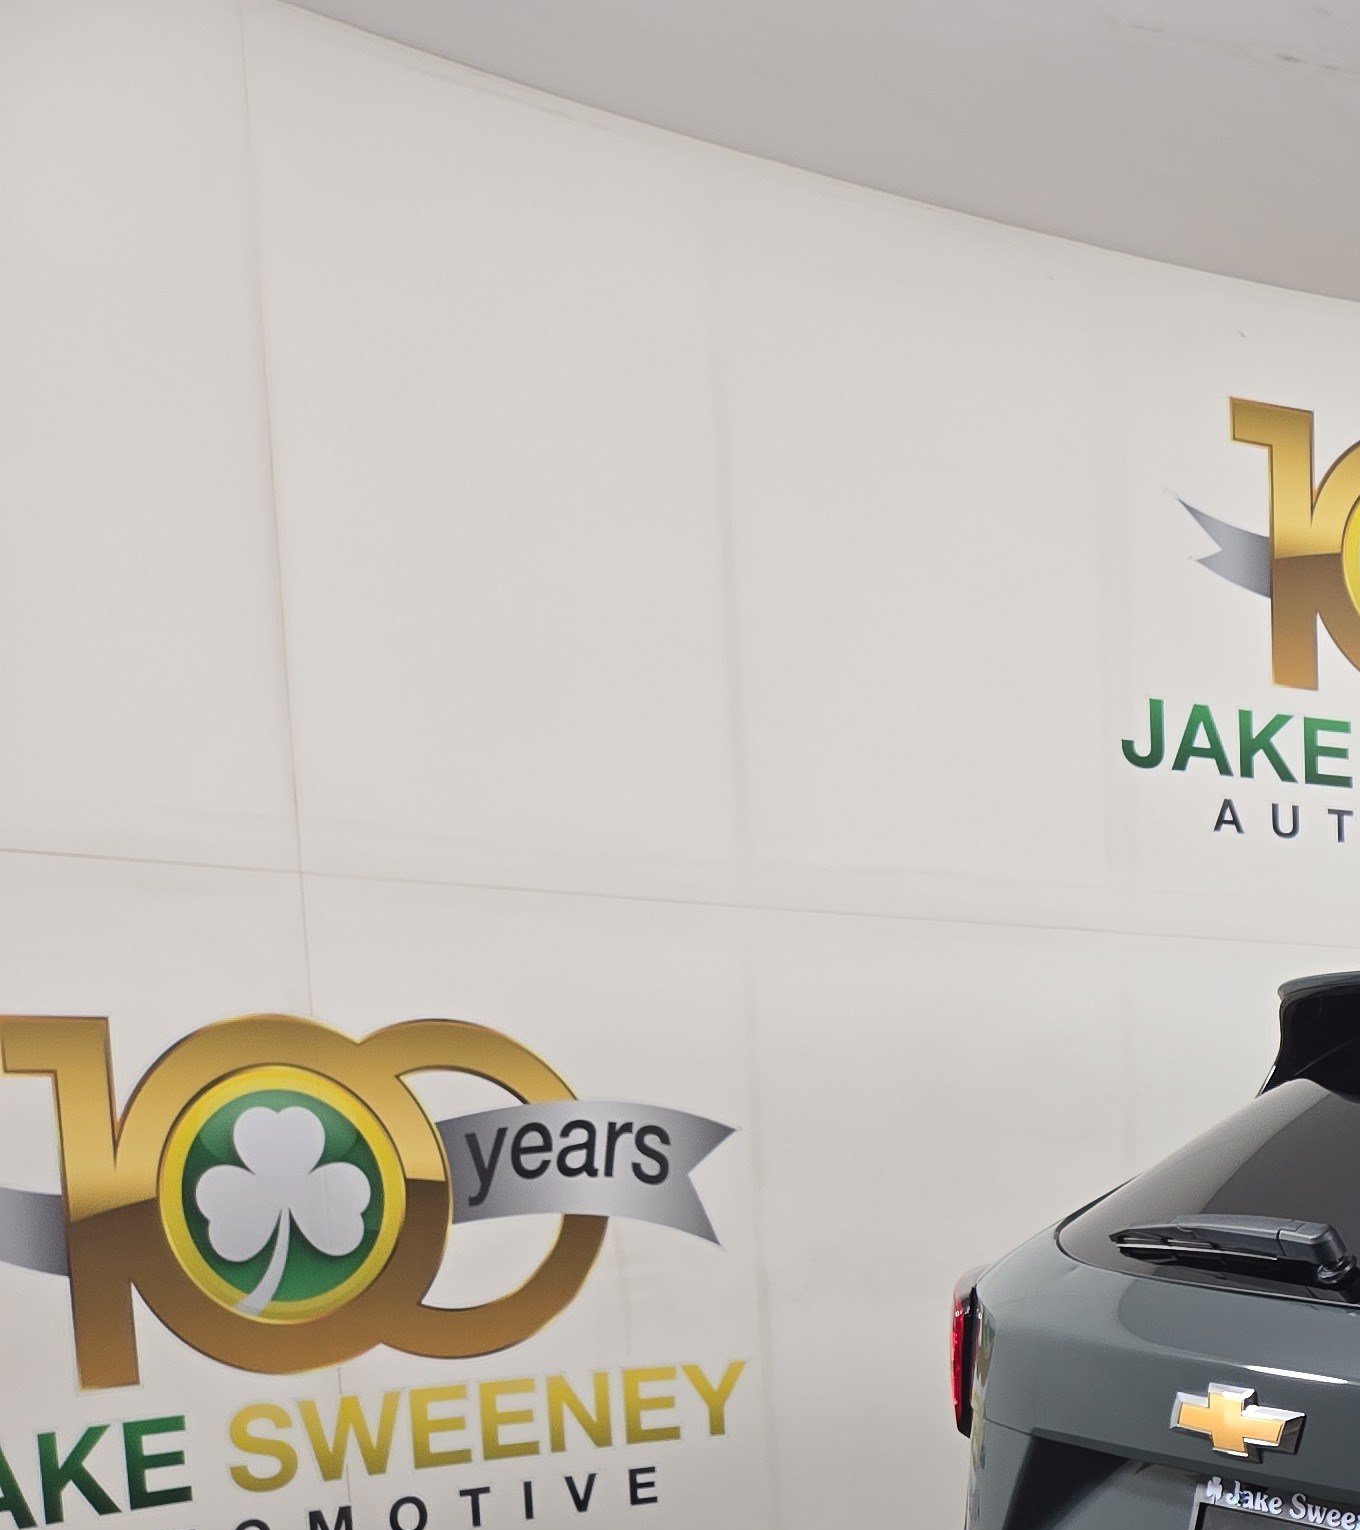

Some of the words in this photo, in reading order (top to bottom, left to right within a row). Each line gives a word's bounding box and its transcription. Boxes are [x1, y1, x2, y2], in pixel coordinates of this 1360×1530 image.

[1120, 697, 1354, 789] JAKE
[464, 1117, 672, 1208] years
[228, 1359, 748, 1494] SWEENEY
[1226, 1481, 1282, 1514] Jake
